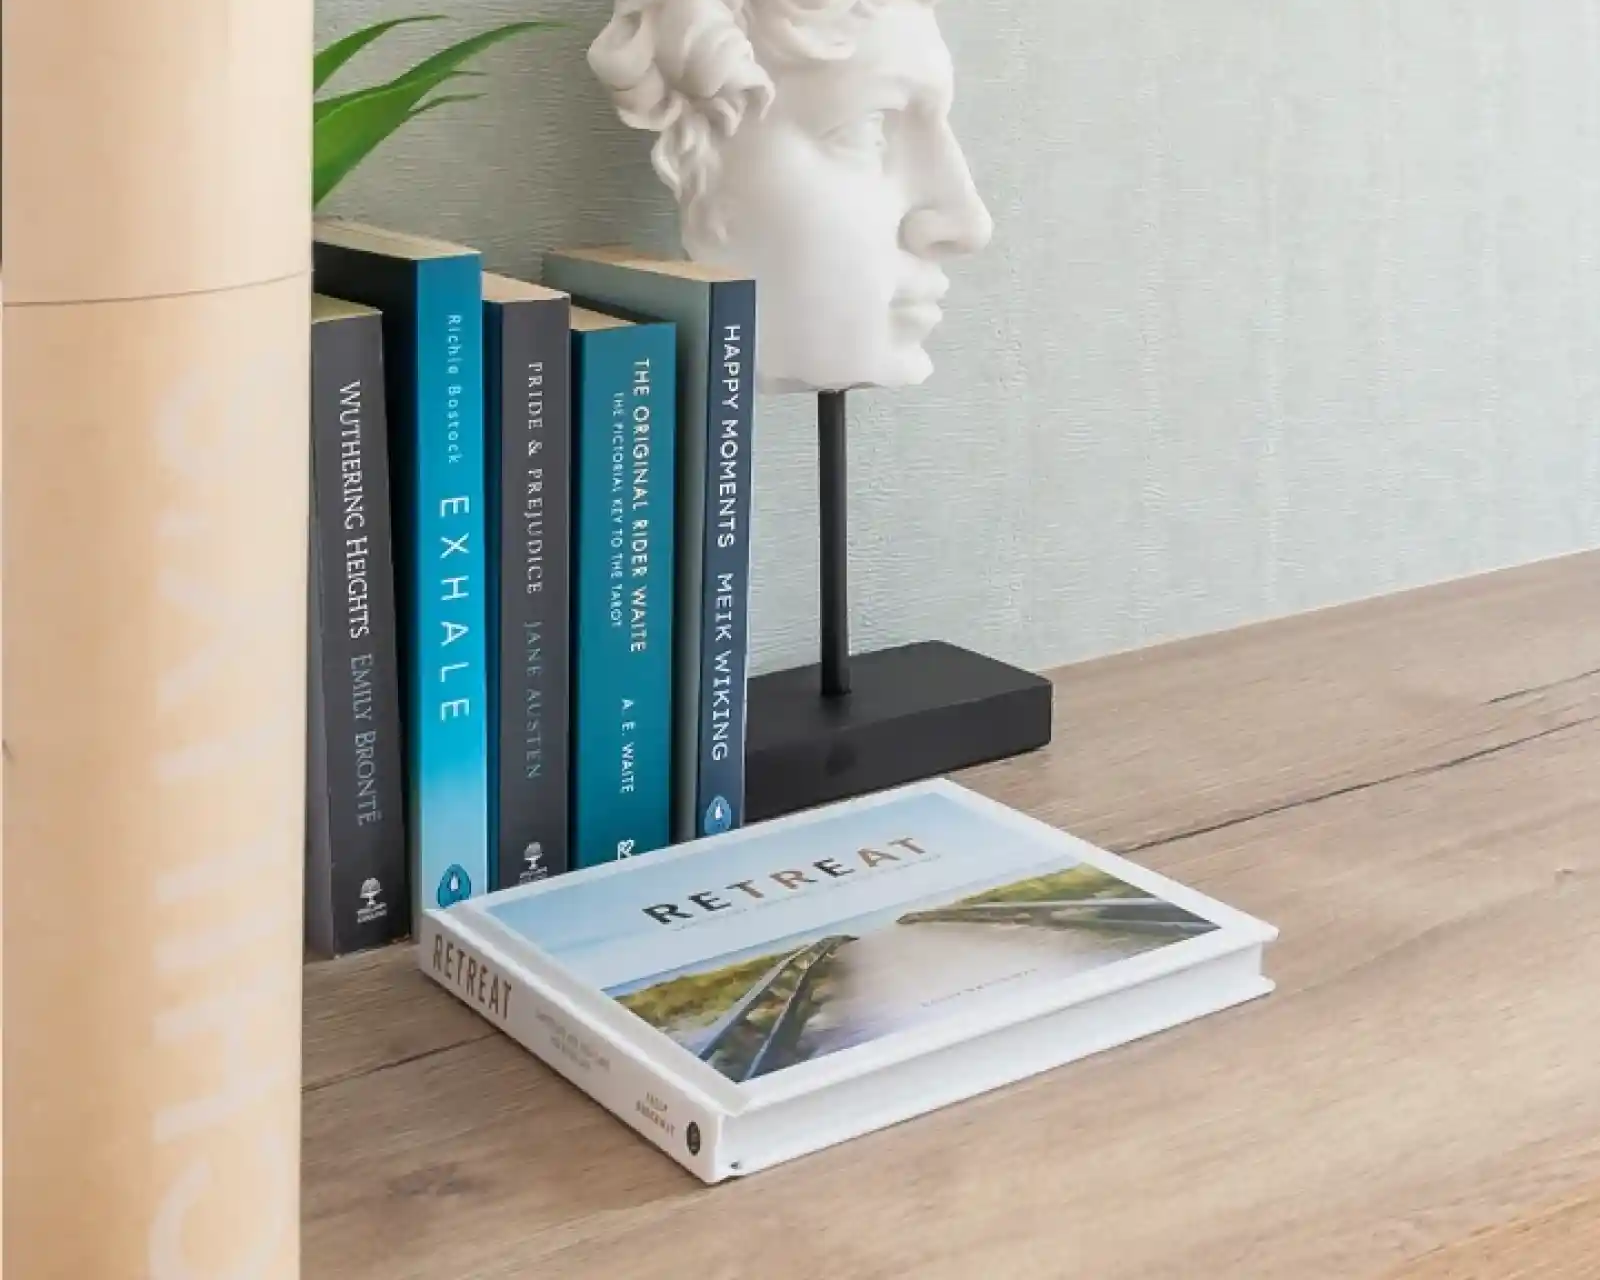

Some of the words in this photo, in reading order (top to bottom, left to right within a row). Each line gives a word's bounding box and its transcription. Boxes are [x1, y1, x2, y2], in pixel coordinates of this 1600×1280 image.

[447, 314, 463, 374] Richie
[633, 357, 651, 397] THE
[722, 323, 741, 410] HAPPY
[448, 384, 463, 464] Bostock
[528, 361, 543, 430] PRIDE
[612, 391, 625, 417] THE
[340, 380, 366, 530] WUTHERING
[528, 439, 543, 457] &
[611, 422, 625, 493] PICTORIAL
[632, 406, 650, 510] ORIGINAL
[611, 498, 624, 523] KEY
[717, 419, 739, 548] MOMENTS
[524, 468, 543, 594] PREJUDICE
[610, 528, 623, 548] TO
[610, 552, 623, 579] THE
[631, 518, 648, 577] RIDER
[346, 535, 370, 639] HEIGHTS
[440, 495, 470, 722] EXHALE
[609, 583, 623, 628] TAROT
[630, 585, 648, 653] WAITE
[715, 572, 734, 641] MEIK
[523, 620, 543, 677] JANE
[350, 653, 374, 721] EMILY
[711, 650, 733, 761] WIKING
[525, 688, 543, 780] AUSTEN
[619, 741, 635, 794] WAITE
[642, 836, 927, 925] RETREAT
[432, 932, 513, 1021] RETREAT
